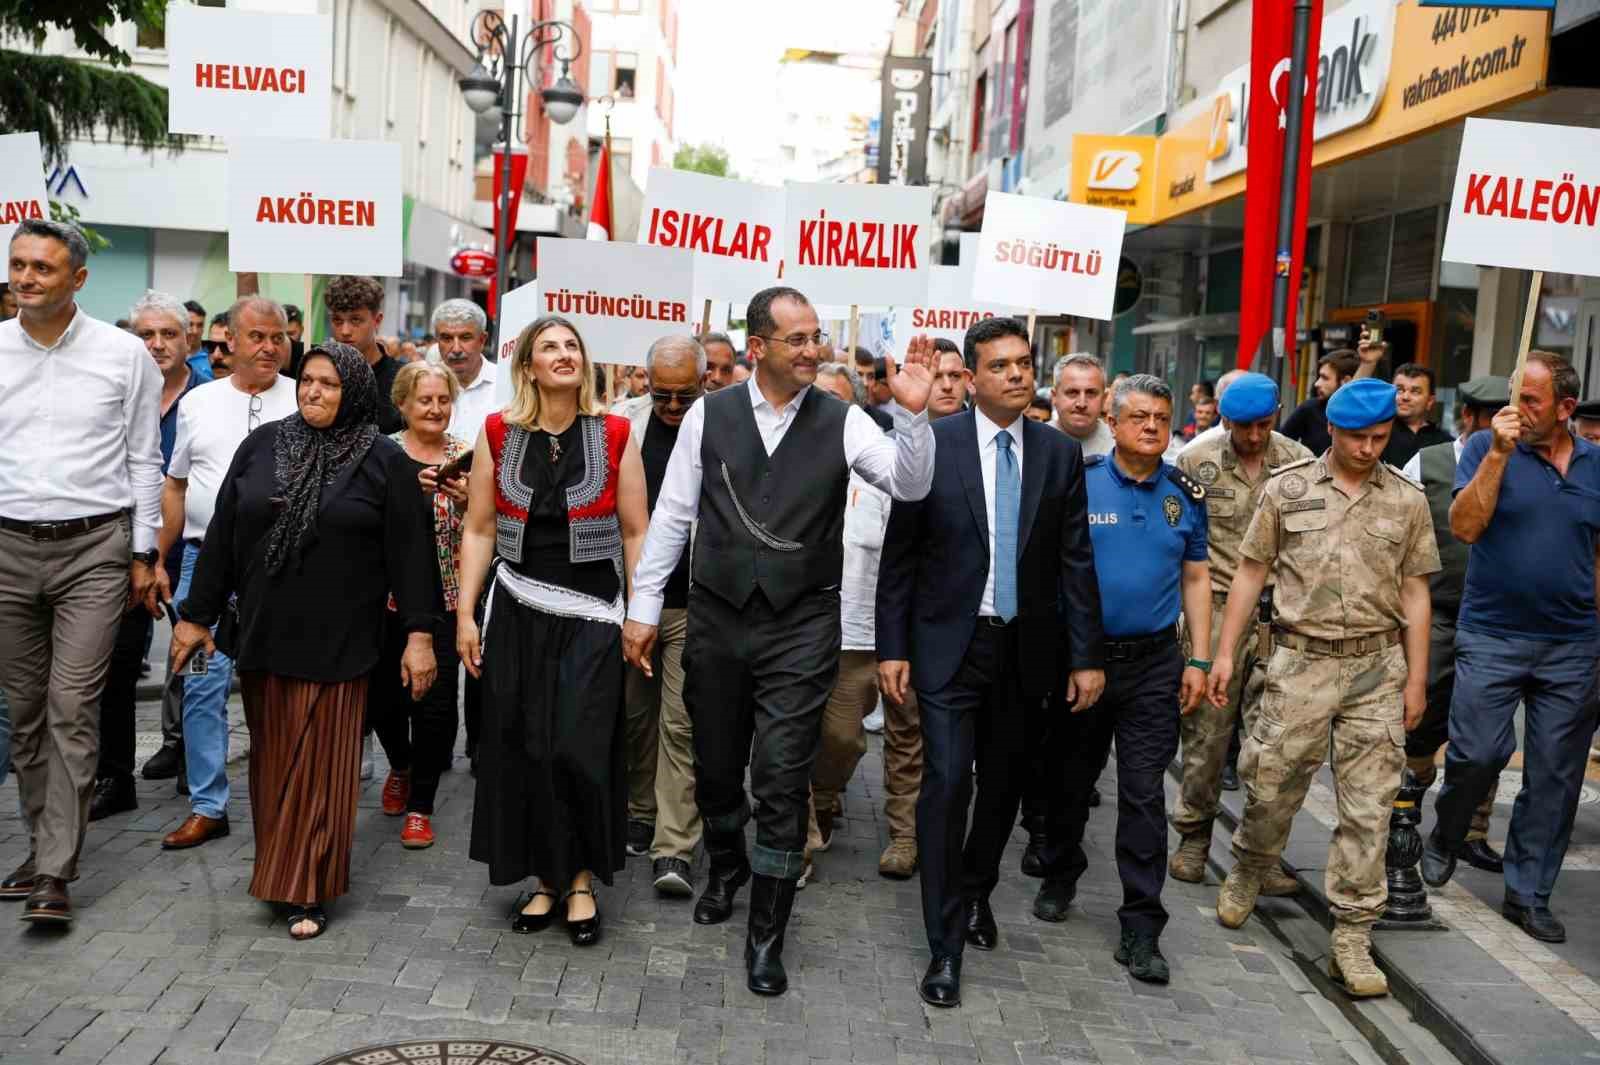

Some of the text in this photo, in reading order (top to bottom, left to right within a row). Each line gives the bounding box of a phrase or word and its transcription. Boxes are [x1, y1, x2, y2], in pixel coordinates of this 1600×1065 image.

[195, 63, 306, 94] HELVACI
[0, 199, 43, 224] AYA
[256, 192, 376, 227] AKÖREN
[798, 209, 919, 270] KİRAZLIK
[994, 238, 1102, 276] SÖĞÜTLÜ
[544, 289, 687, 322] TÜTÜNCÜLER
[1087, 512, 1119, 525] OLIS
